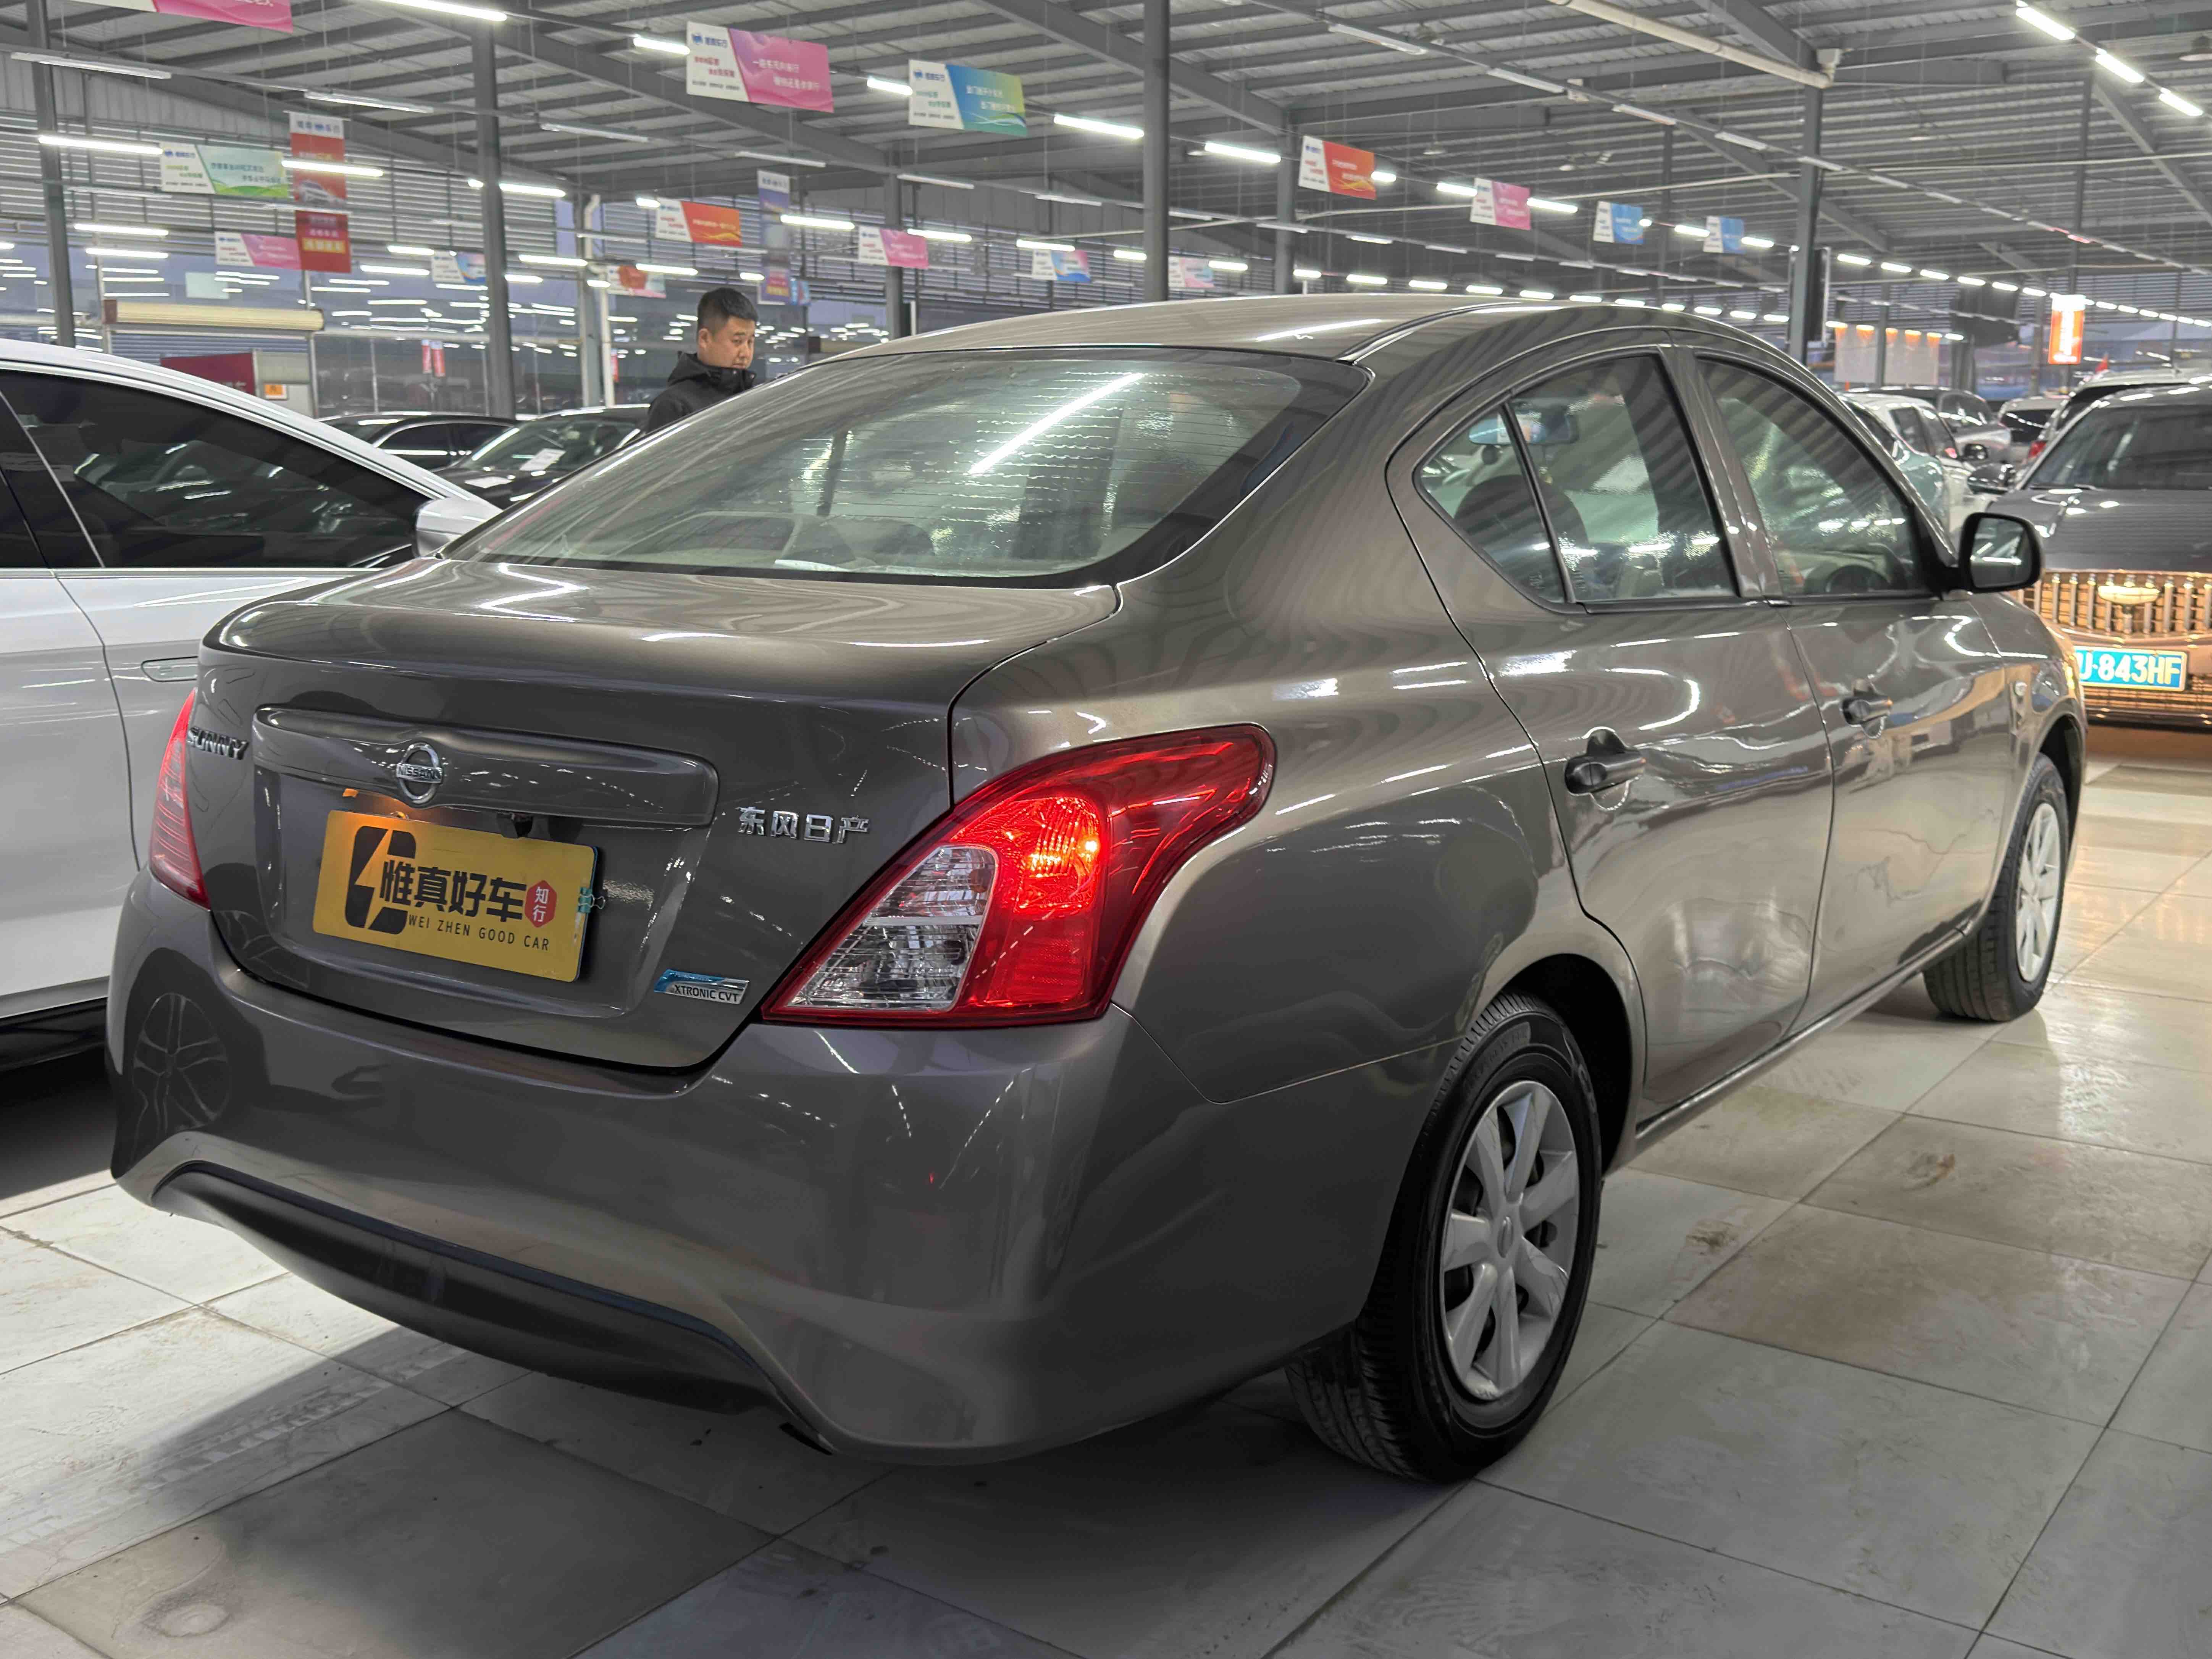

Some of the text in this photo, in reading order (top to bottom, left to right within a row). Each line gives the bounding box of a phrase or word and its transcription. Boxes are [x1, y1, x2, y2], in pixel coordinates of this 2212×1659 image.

[187, 726, 249, 760] SUNNY
[397, 765, 441, 780] NISSAN
[735, 806, 869, 843] 东风日产
[379, 860, 527, 922] 惟真好车
[532, 886, 549, 923] 知行
[408, 914, 549, 951] WEI ZHEN GOOD CAR
[674, 984, 739, 1002] XTRONIC CVT
